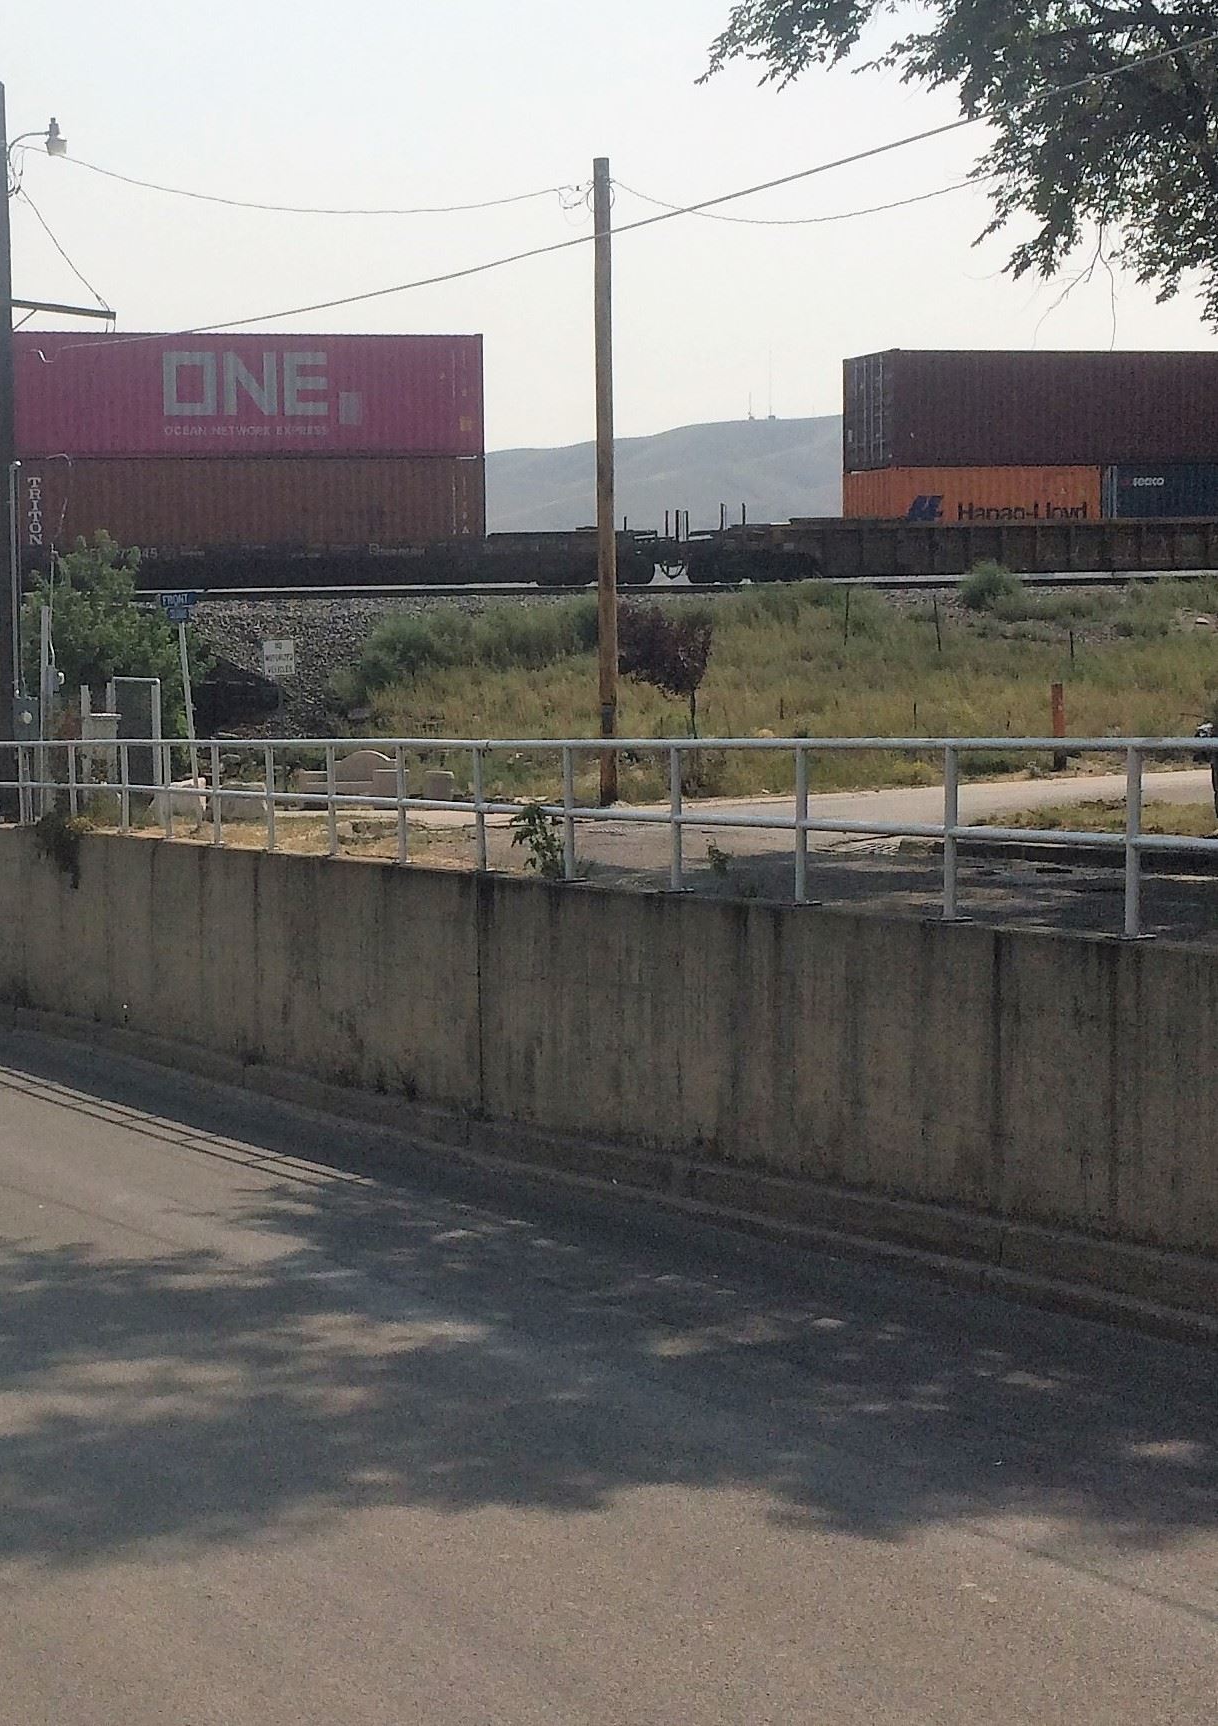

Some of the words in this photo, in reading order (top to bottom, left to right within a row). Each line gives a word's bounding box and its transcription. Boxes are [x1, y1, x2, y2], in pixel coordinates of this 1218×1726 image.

[162, 351, 328, 417] ONE
[163, 425, 207, 436] OCEAN
[211, 425, 271, 436] NETWORK
[275, 425, 329, 436] EXPRESS
[27, 477, 43, 546] TRITON
[161, 593, 188, 606] FRONT
